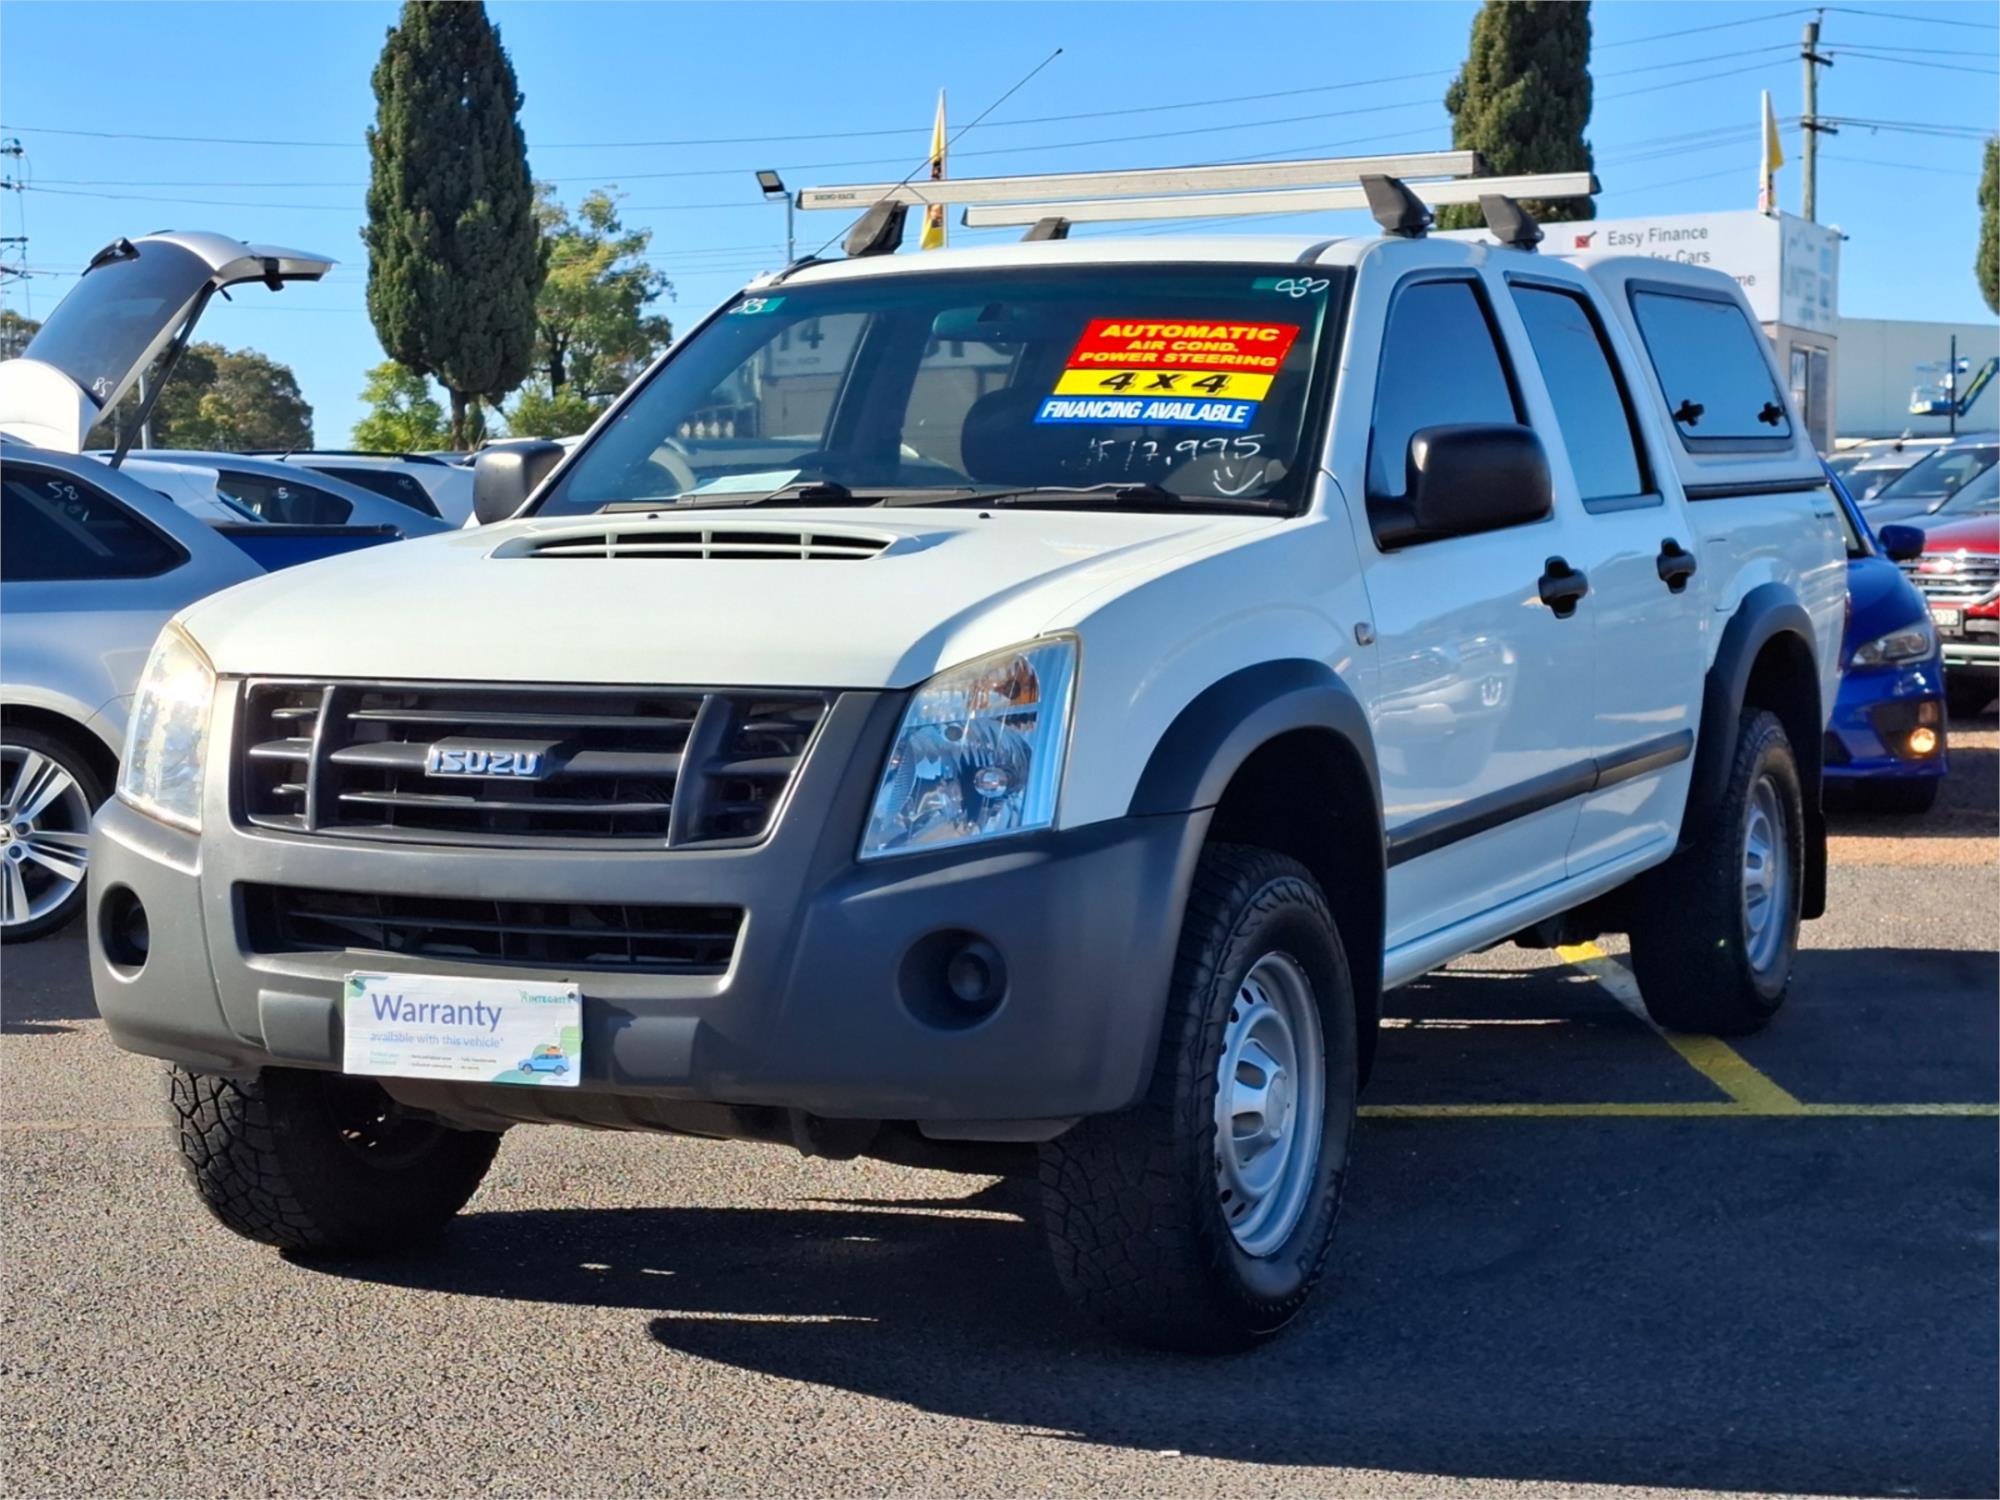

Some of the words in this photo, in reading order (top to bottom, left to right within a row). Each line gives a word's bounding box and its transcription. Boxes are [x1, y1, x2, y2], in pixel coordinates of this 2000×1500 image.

[1608, 231, 1644, 247] Easy
[1648, 227, 1708, 243] Finance
[1675, 249, 1711, 264] Cars
[1100, 324, 1281, 341] AUTOMATIC
[1126, 340, 1167, 350] AIR
[1171, 341, 1239, 352] COND.
[1078, 352, 1158, 362] POWER
[1163, 352, 1277, 367] STEERING
[1099, 372, 1138, 393] 4
[1191, 373, 1231, 396] 4
[1041, 400, 1145, 419] FINANCING
[1142, 401, 1249, 423] AVAILABLE
[431, 749, 539, 776] ISUZU
[371, 993, 502, 1033] Warranty
[370, 1031, 414, 1043] available
[416, 1033, 439, 1045] with
[442, 1034, 461, 1046] this
